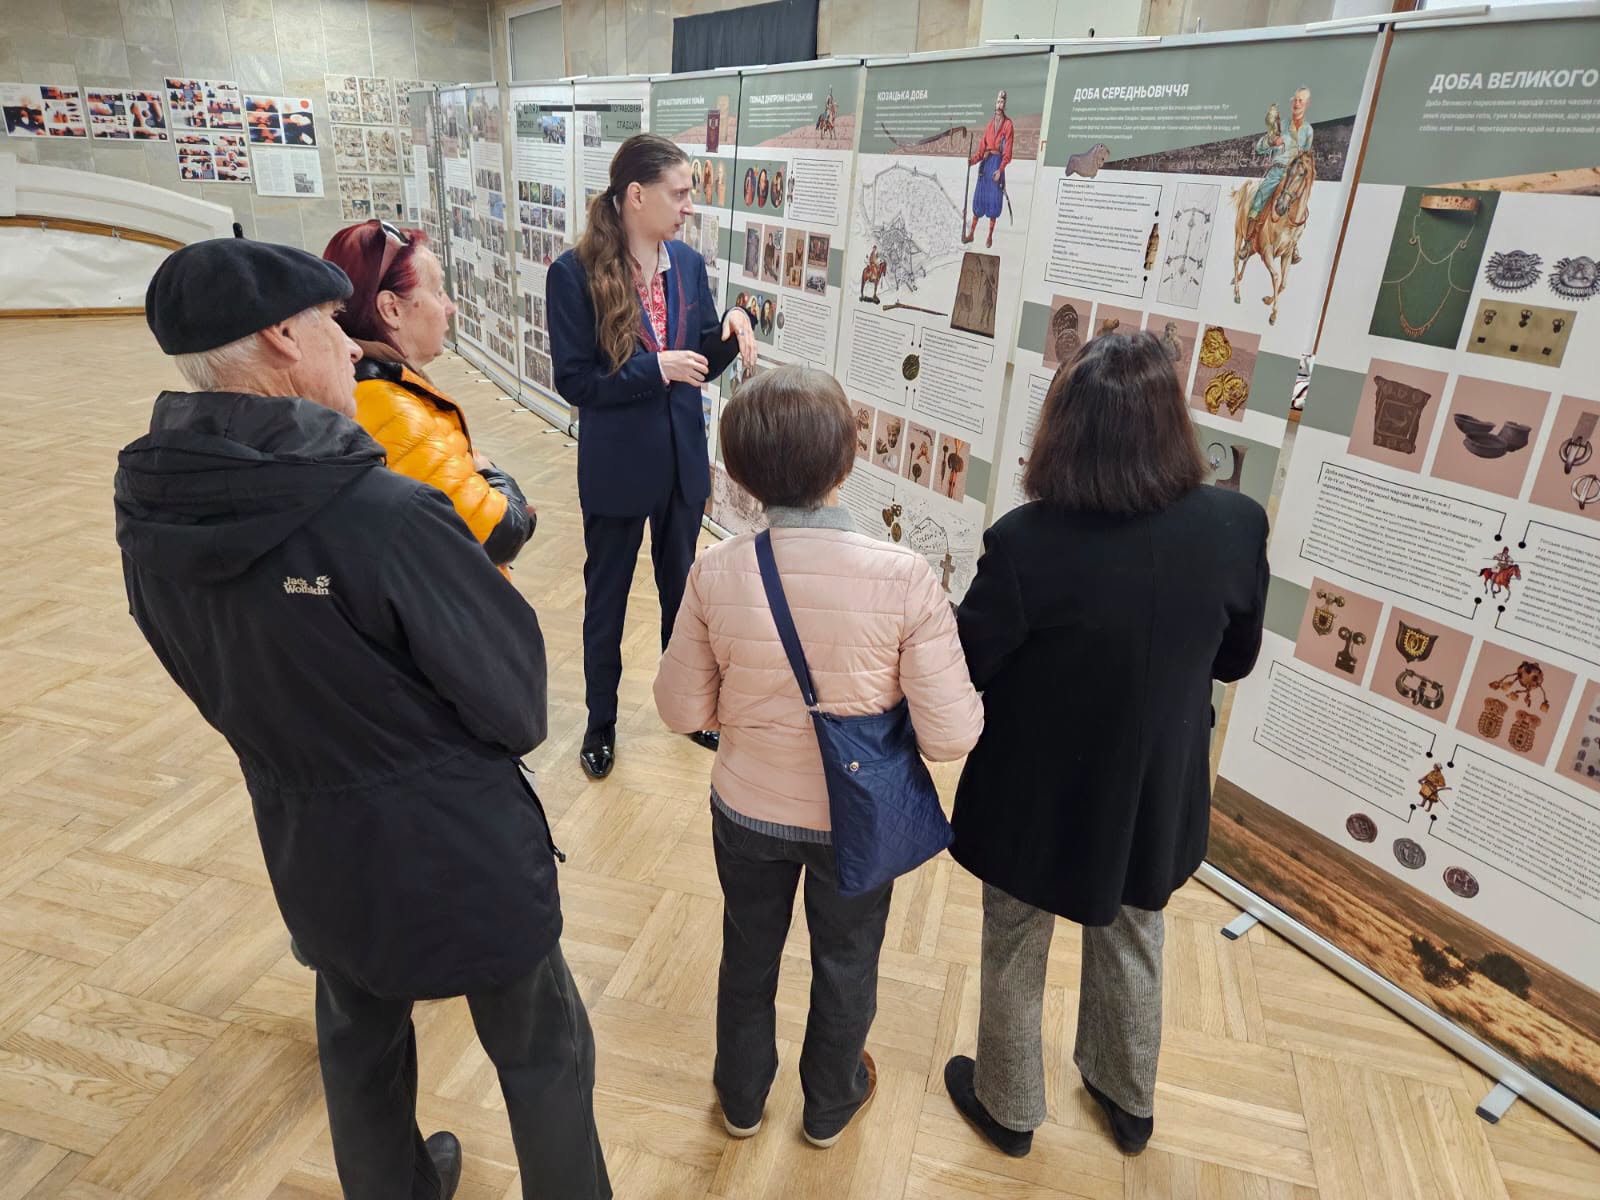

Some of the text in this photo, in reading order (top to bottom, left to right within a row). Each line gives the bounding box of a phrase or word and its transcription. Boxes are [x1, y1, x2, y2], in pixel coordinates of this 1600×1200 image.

[1429, 69, 1600, 93] ДОБА ВЕЛИКОГО
[877, 89, 928, 102] КОЗАЦЬКА ДОБА
[1073, 83, 1190, 102] ДОБА СЕРЕДНЬОВІЧЧЯ
